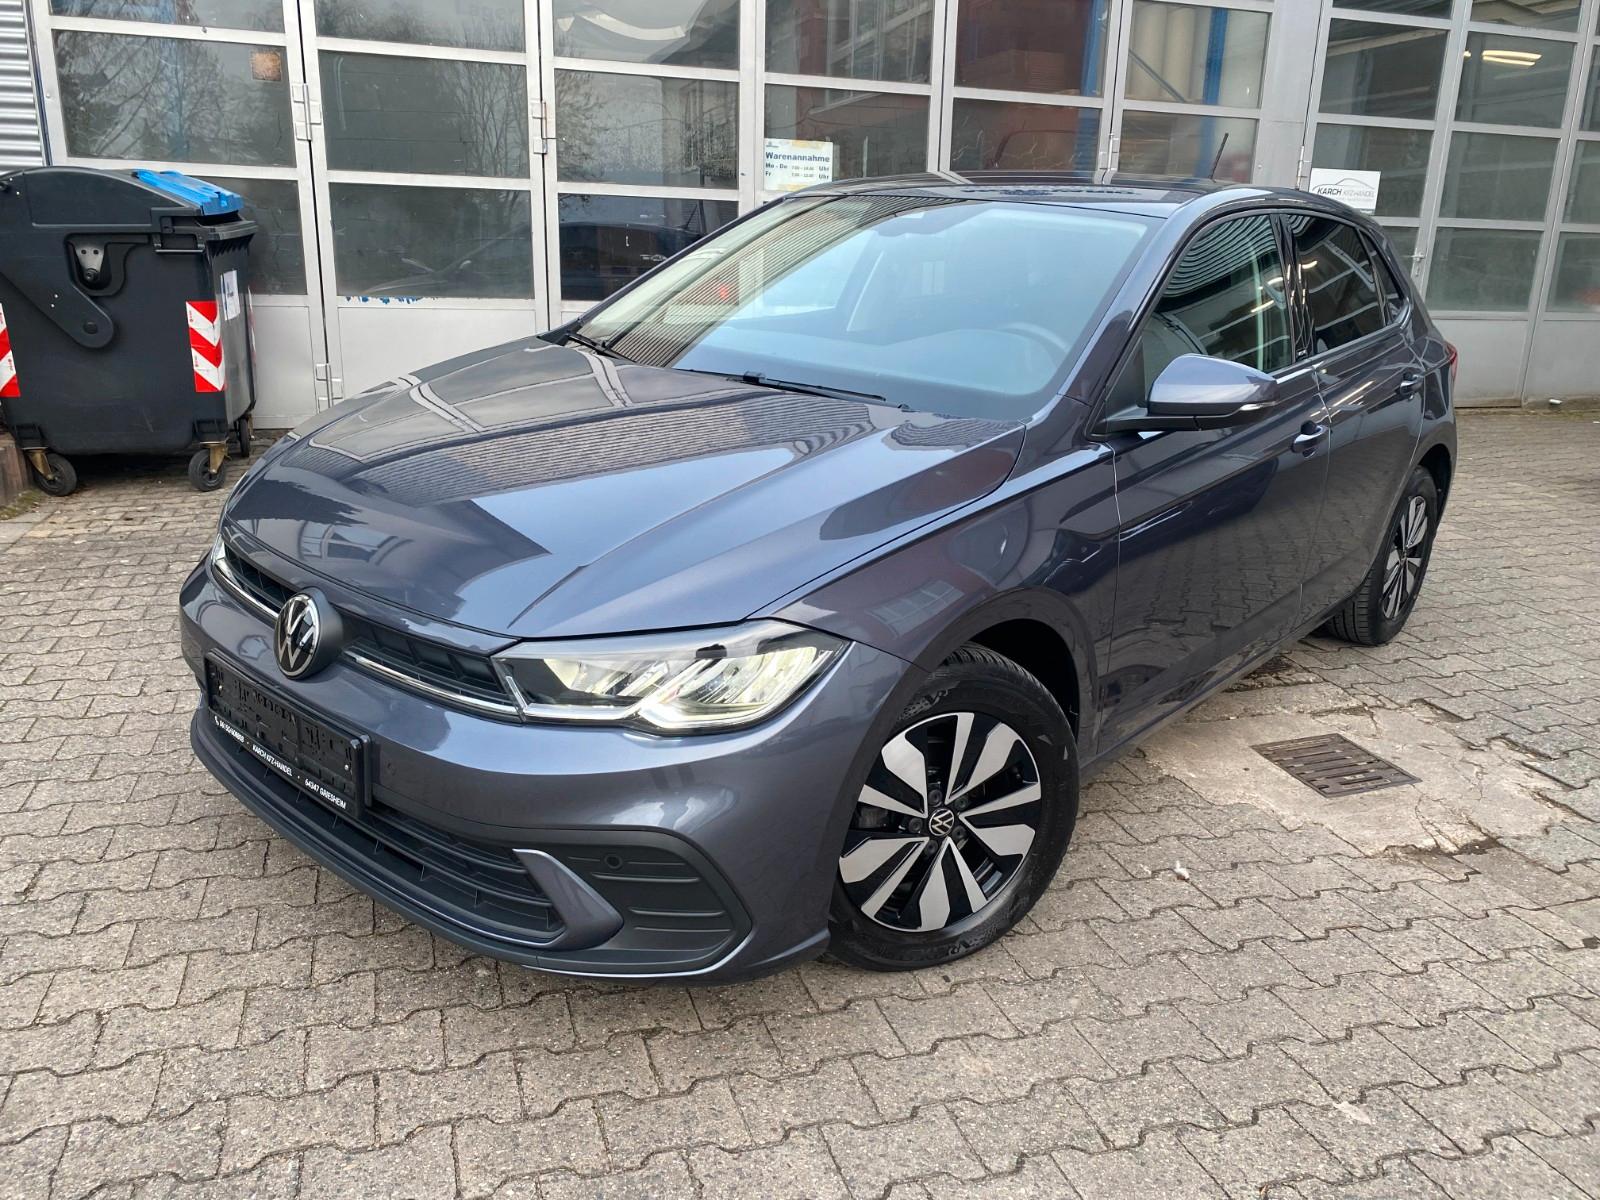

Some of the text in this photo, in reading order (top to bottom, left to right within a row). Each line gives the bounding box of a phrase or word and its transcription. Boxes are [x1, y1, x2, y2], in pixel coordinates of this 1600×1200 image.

[765, 151, 830, 162] Warenannahme
[1317, 187, 1342, 196] KARCH
[252, 744, 347, 809] KARCH KFZ-HANDEL 64347 GRIESHEIM
